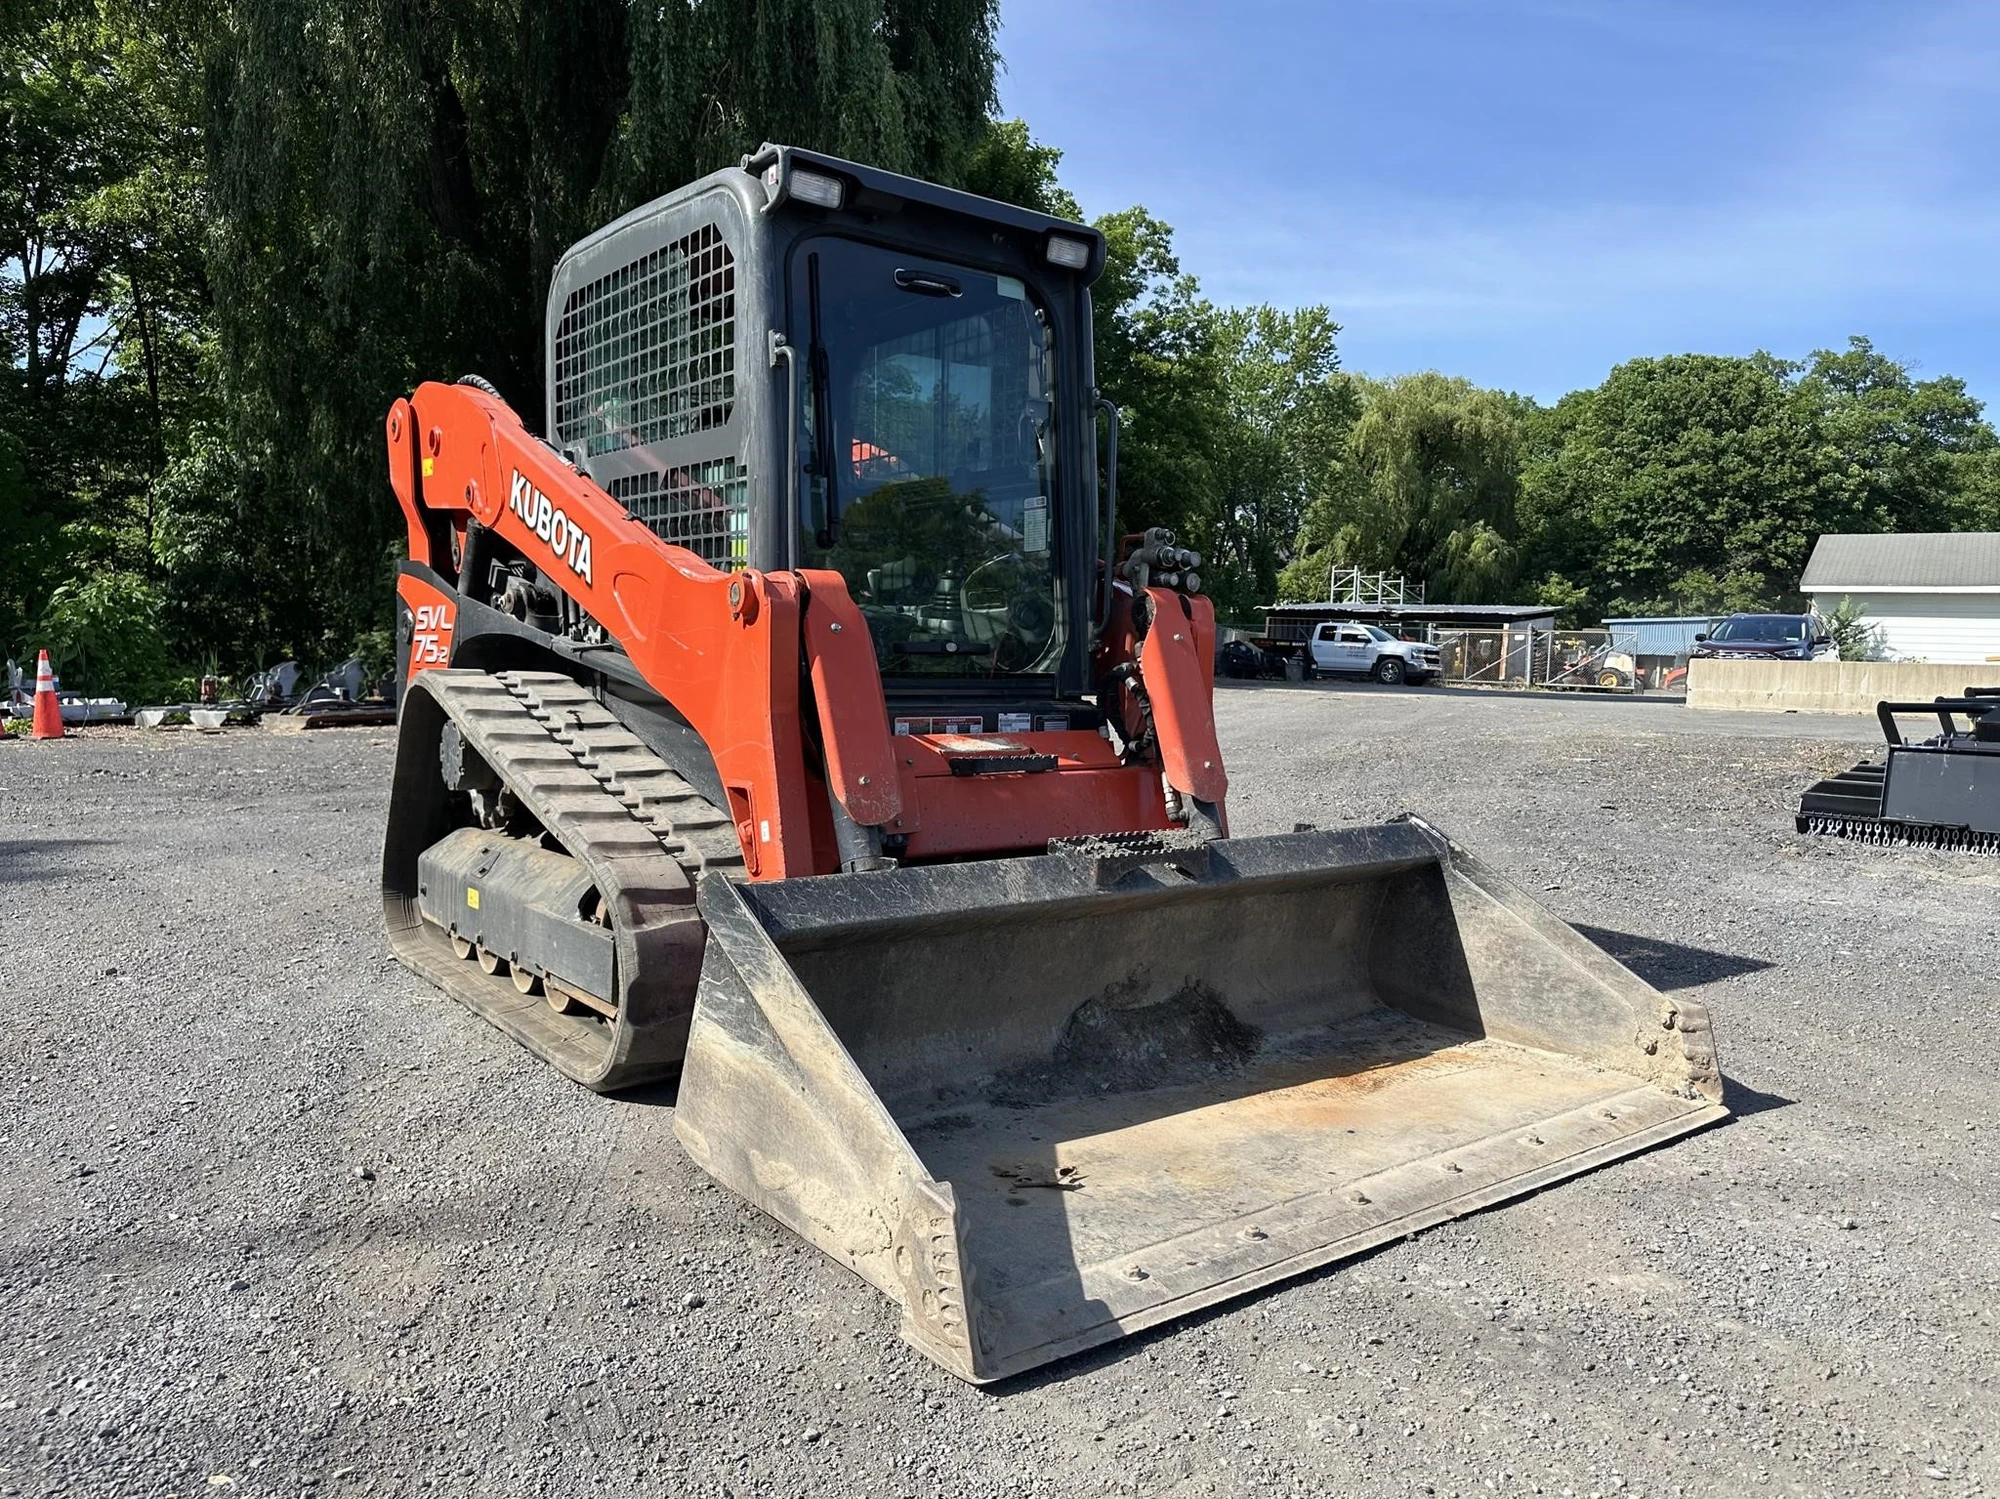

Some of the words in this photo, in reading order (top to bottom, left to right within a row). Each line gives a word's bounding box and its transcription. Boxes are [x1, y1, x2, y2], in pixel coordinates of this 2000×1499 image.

[509, 467, 592, 588] KUBOTA
[416, 605, 453, 631] SVL
[414, 634, 448, 664] 75-2
